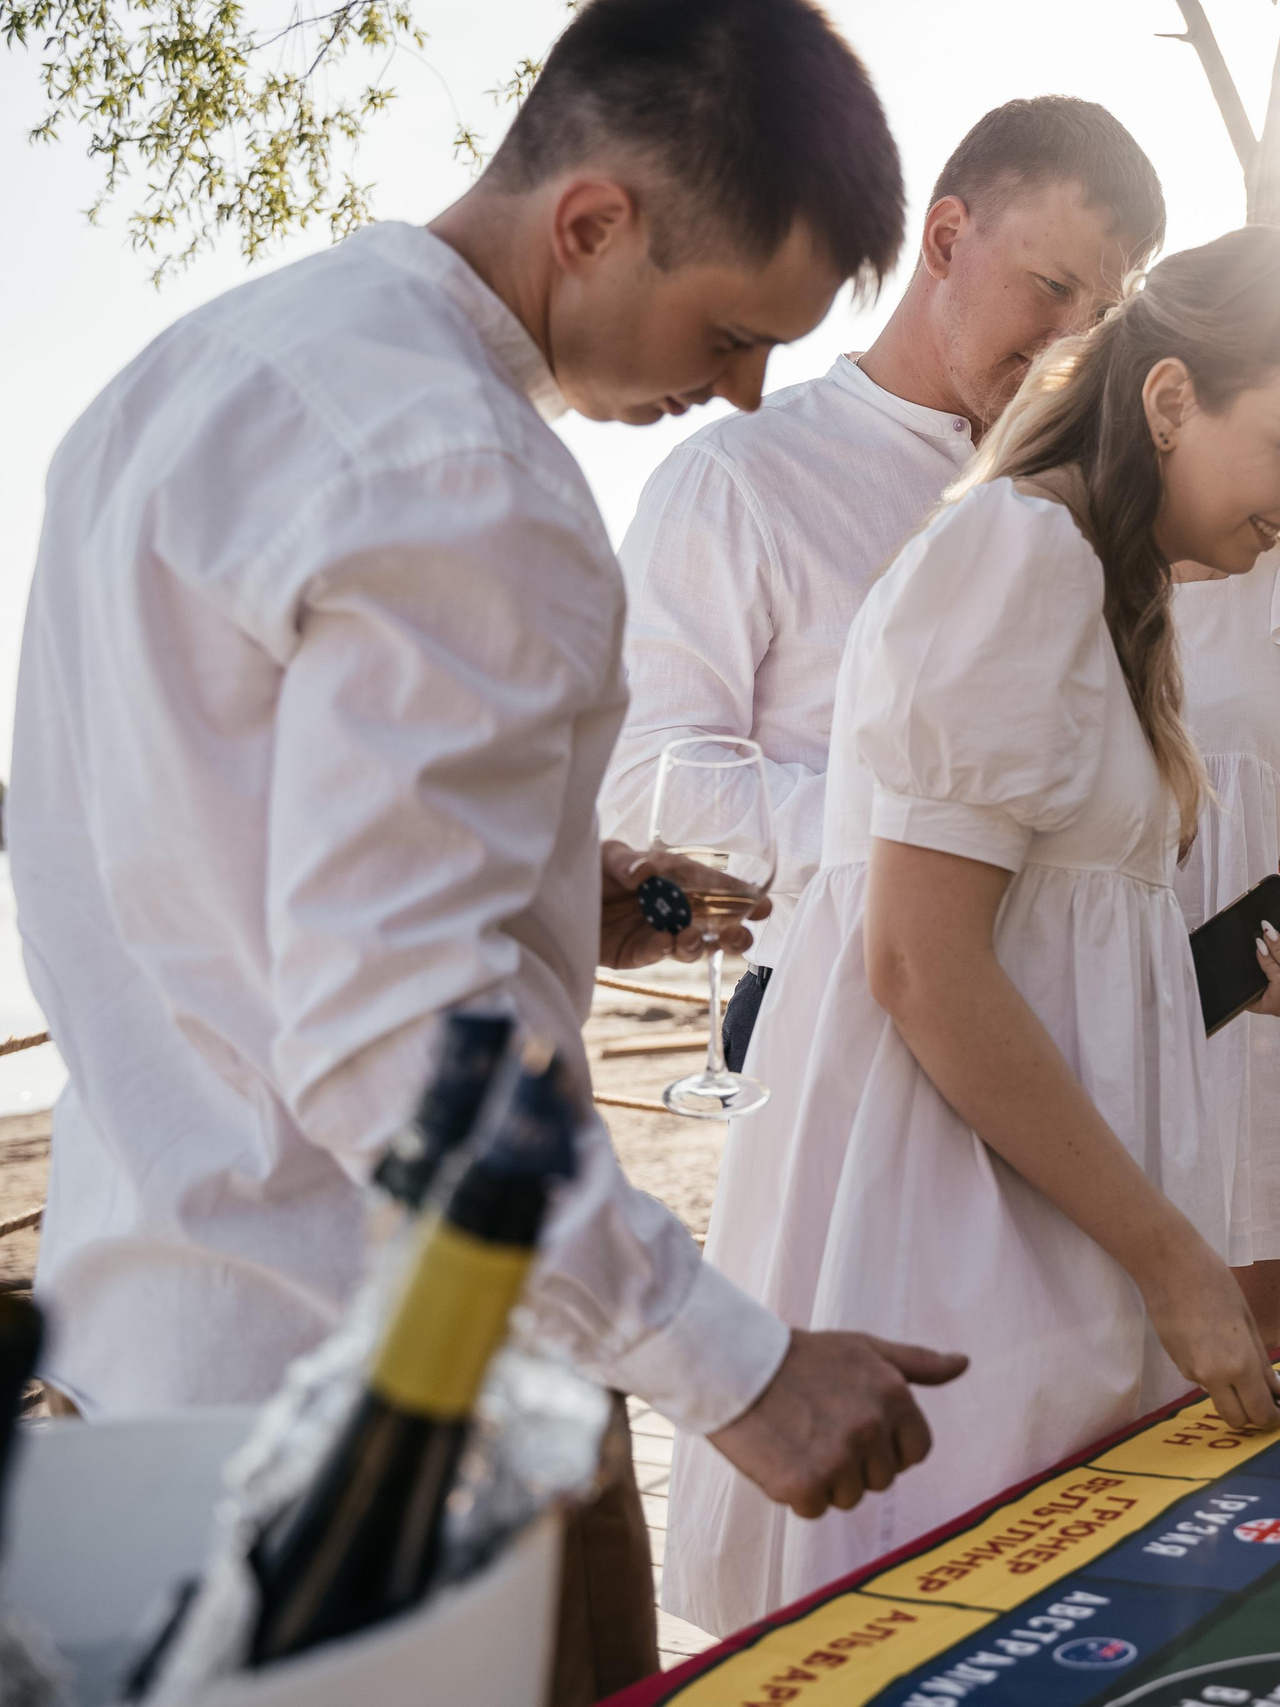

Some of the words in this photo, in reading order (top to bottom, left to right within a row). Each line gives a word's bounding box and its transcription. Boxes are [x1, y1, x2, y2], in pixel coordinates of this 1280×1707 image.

[917, 1475, 1127, 1594] ВЕЛЬТЛИНЕР
[1007, 1495, 1140, 1576] ГРЮНЕР
[1143, 1493, 1260, 1558] ГРУЗИЯ
